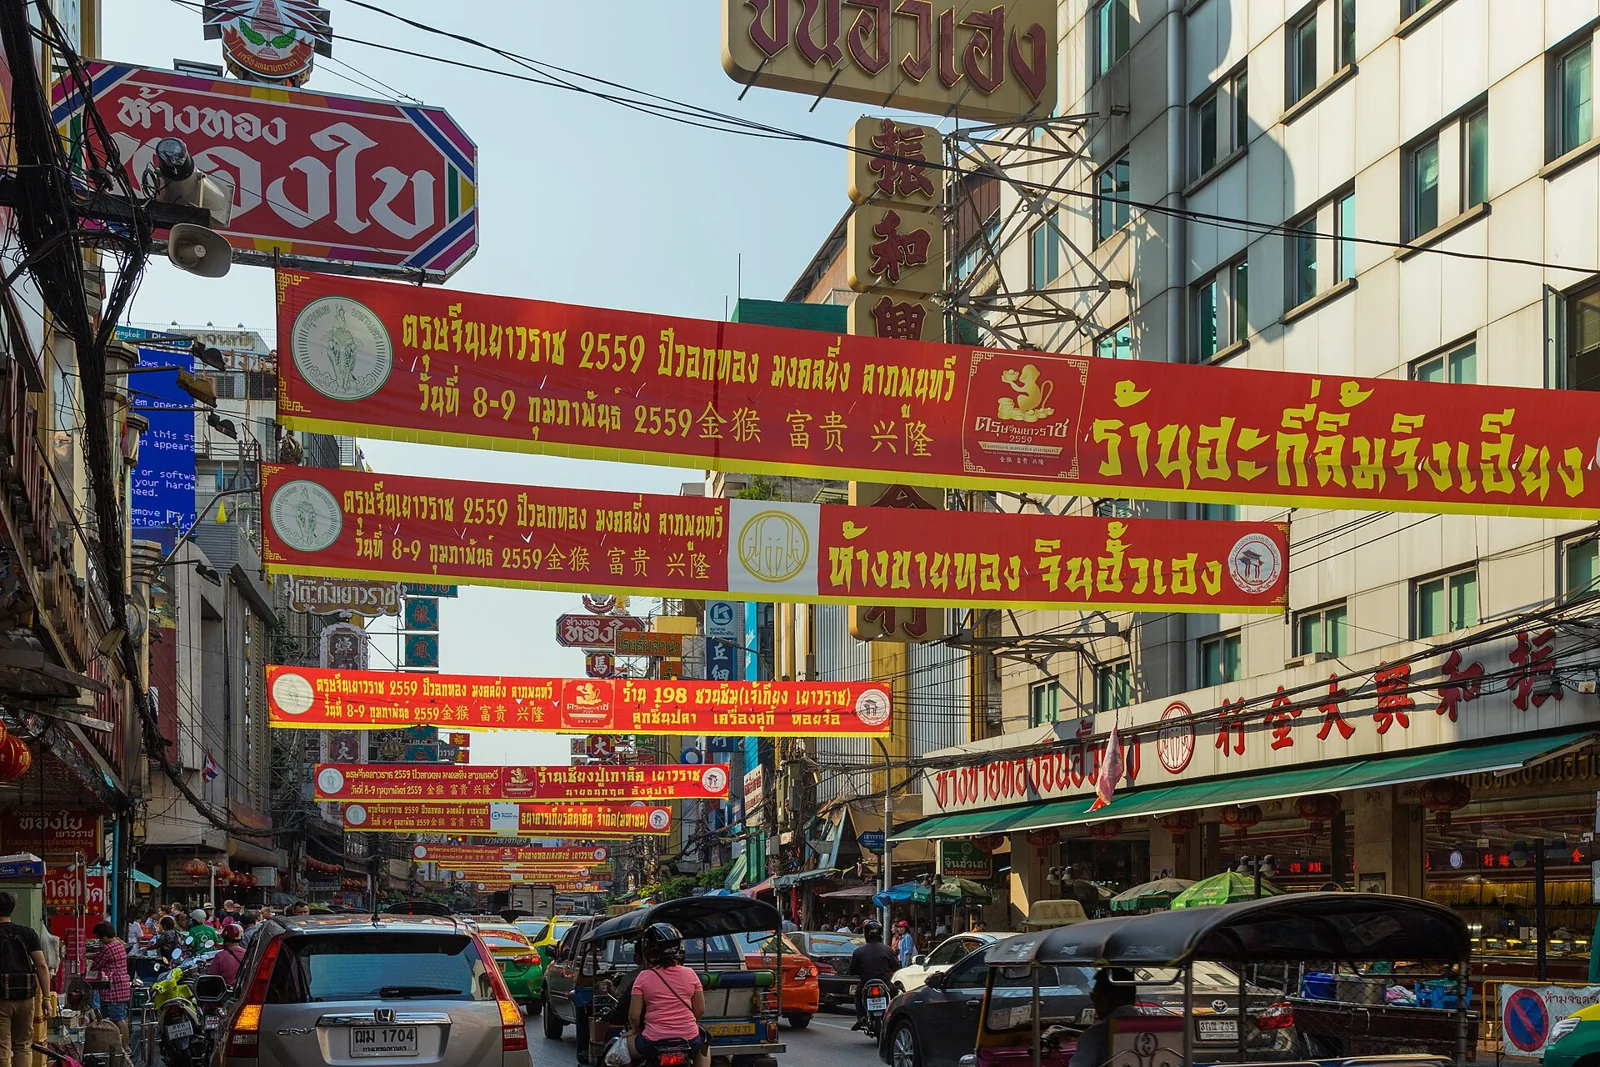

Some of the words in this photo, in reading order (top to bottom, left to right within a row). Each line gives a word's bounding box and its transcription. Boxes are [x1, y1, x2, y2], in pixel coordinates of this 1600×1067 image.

[117, 86, 287, 146] ห้างทอง
[402, 303, 566, 373] ตรุษจีนเยาวราช
[579, 331, 645, 374] 2559
[657, 327, 759, 384] ปีวอกทอง
[770, 332, 855, 393] มงคลยิ่ง
[862, 355, 957, 418] ลาภพูนทวี
[419, 364, 459, 417] วันที่
[473, 386, 517, 420] 8-9
[528, 387, 621, 441] กุมภาพันธ์
[634, 404, 692, 438] 2559
[697, 402, 761, 443] 金猴
[785, 409, 848, 452] 富贵
[871, 415, 933, 457] 兴隆
[153, 430, 177, 440] this
[974, 416, 1070, 437] ตรุษจีนเยาวราช
[1009, 435, 1033, 444] 2559
[1093, 379, 1585, 502] ร้านฮะกี่ลิ้มจิงเฮียง
[135, 478, 159, 488] your
[344, 482, 455, 526] ตรุษจีนเยาวราช
[463, 498, 509, 526] 2559
[517, 493, 587, 530] ปีวอกทอง
[596, 495, 650, 534] มงคลยิ่ง
[659, 505, 723, 551] ลาภพูนทวี
[356, 530, 383, 560] วันที่
[392, 538, 421, 561] 8-9
[429, 535, 493, 575] กุมภาพันธ์
[502, 547, 542, 570] 2559
[829, 521, 1021, 594] ห้างขายทอง
[1035, 521, 1222, 600] จินฮั้วเฮง
[616, 633, 681, 654] โรงรับจำนำ
[593, 656, 608, 674] 馬
[315, 672, 385, 702] ตรุษจีนเยาวราช
[390, 680, 418, 697] 2559
[422, 677, 467, 697] ปีวอกทอง
[471, 676, 506, 700] มงคลยิ่ง
[623, 680, 647, 703] ร้าน
[653, 686, 688, 704] 198
[324, 693, 343, 718] วันที่
[347, 703, 365, 718] 8-9
[414, 706, 440, 721] 2559
[632, 704, 697, 730] ลูกชิ้นปลา
[594, 737, 610, 755] 大
[394, 770, 411, 780] 2559
[652, 769, 700, 783] เยาวราช
[407, 785, 422, 795] 2559
[382, 1029, 415, 1043] 1704
